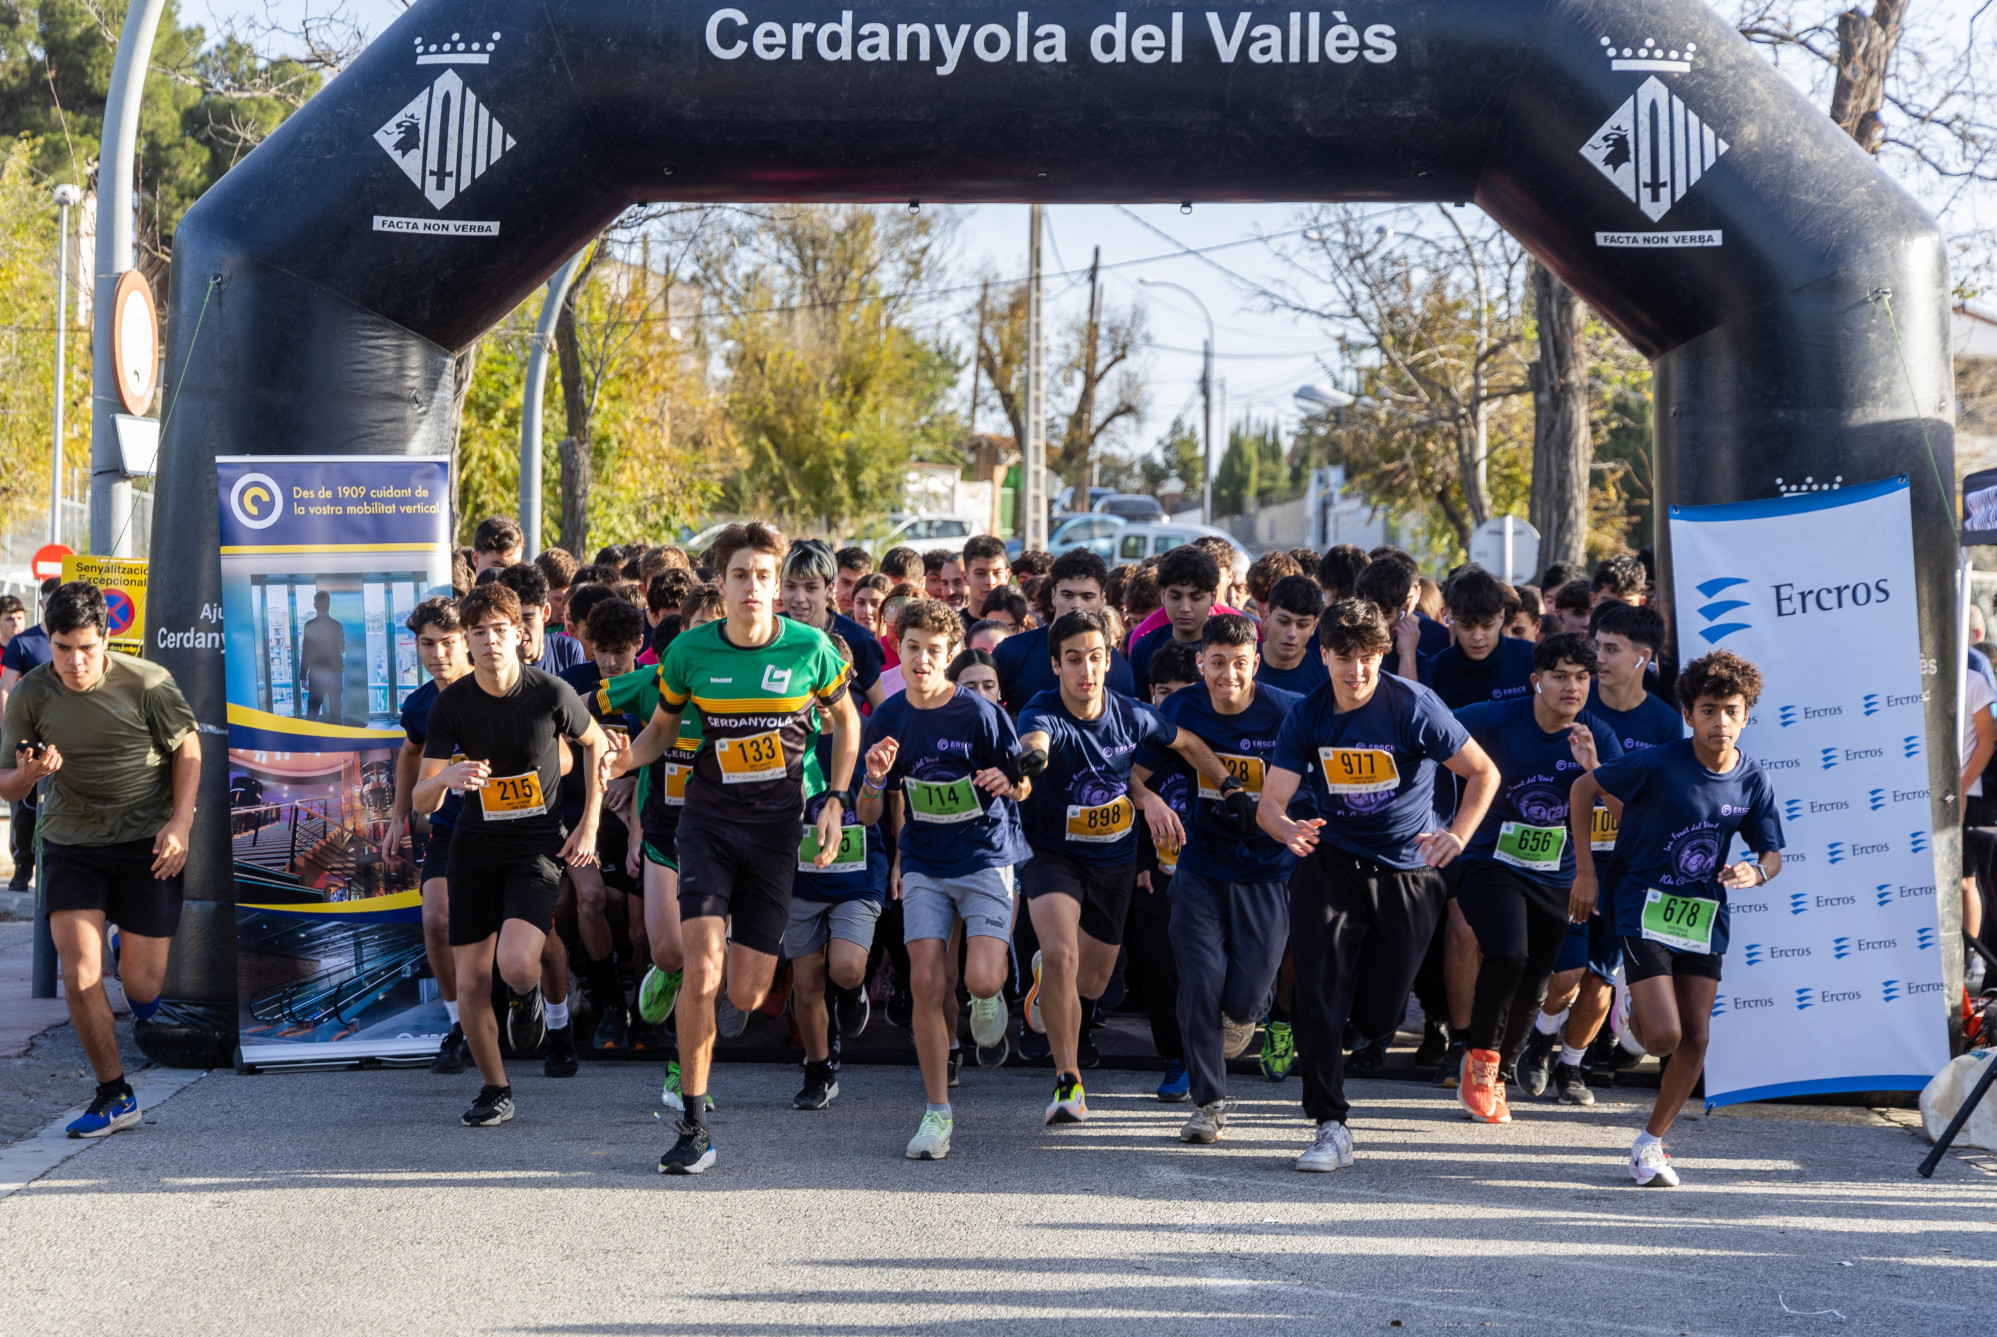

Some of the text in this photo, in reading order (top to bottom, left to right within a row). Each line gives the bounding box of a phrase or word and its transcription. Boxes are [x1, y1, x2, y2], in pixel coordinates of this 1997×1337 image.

[704, 7, 1398, 76] Cerdanyola del Vallès
[381, 219, 493, 233] FACTA NON VERBA
[1603, 234, 1716, 245] FACTA NON VERBA
[292, 485, 429, 499] Des de 1909 cuidant de
[293, 501, 440, 515] la vostra mobilitat vertical
[1770, 577, 1891, 618] Ercros
[1804, 704, 1843, 719] Ercros
[737, 736, 776, 763] 133
[1845, 747, 1884, 761] Ercros
[1220, 757, 1250, 782] 28
[1340, 752, 1375, 775] 977
[1760, 757, 1800, 771] Ercros
[497, 777, 533, 801] 215
[922, 785, 960, 807] 714
[1892, 787, 1931, 802] Ercros
[1810, 800, 1850, 814] Ercros
[1087, 803, 1121, 829] 898
[1518, 829, 1553, 852] 656
[1852, 842, 1890, 857] Ercros
[1728, 902, 1769, 915] Ercros
[1816, 894, 1856, 908] Ercros
[1662, 897, 1700, 928] 678
[1858, 937, 1898, 951] Ercros
[1770, 946, 1812, 959] Ercros
[1907, 980, 1945, 995] Ercros
[1734, 997, 1775, 1010] Ercros
[1822, 989, 1862, 1003] Ercros
